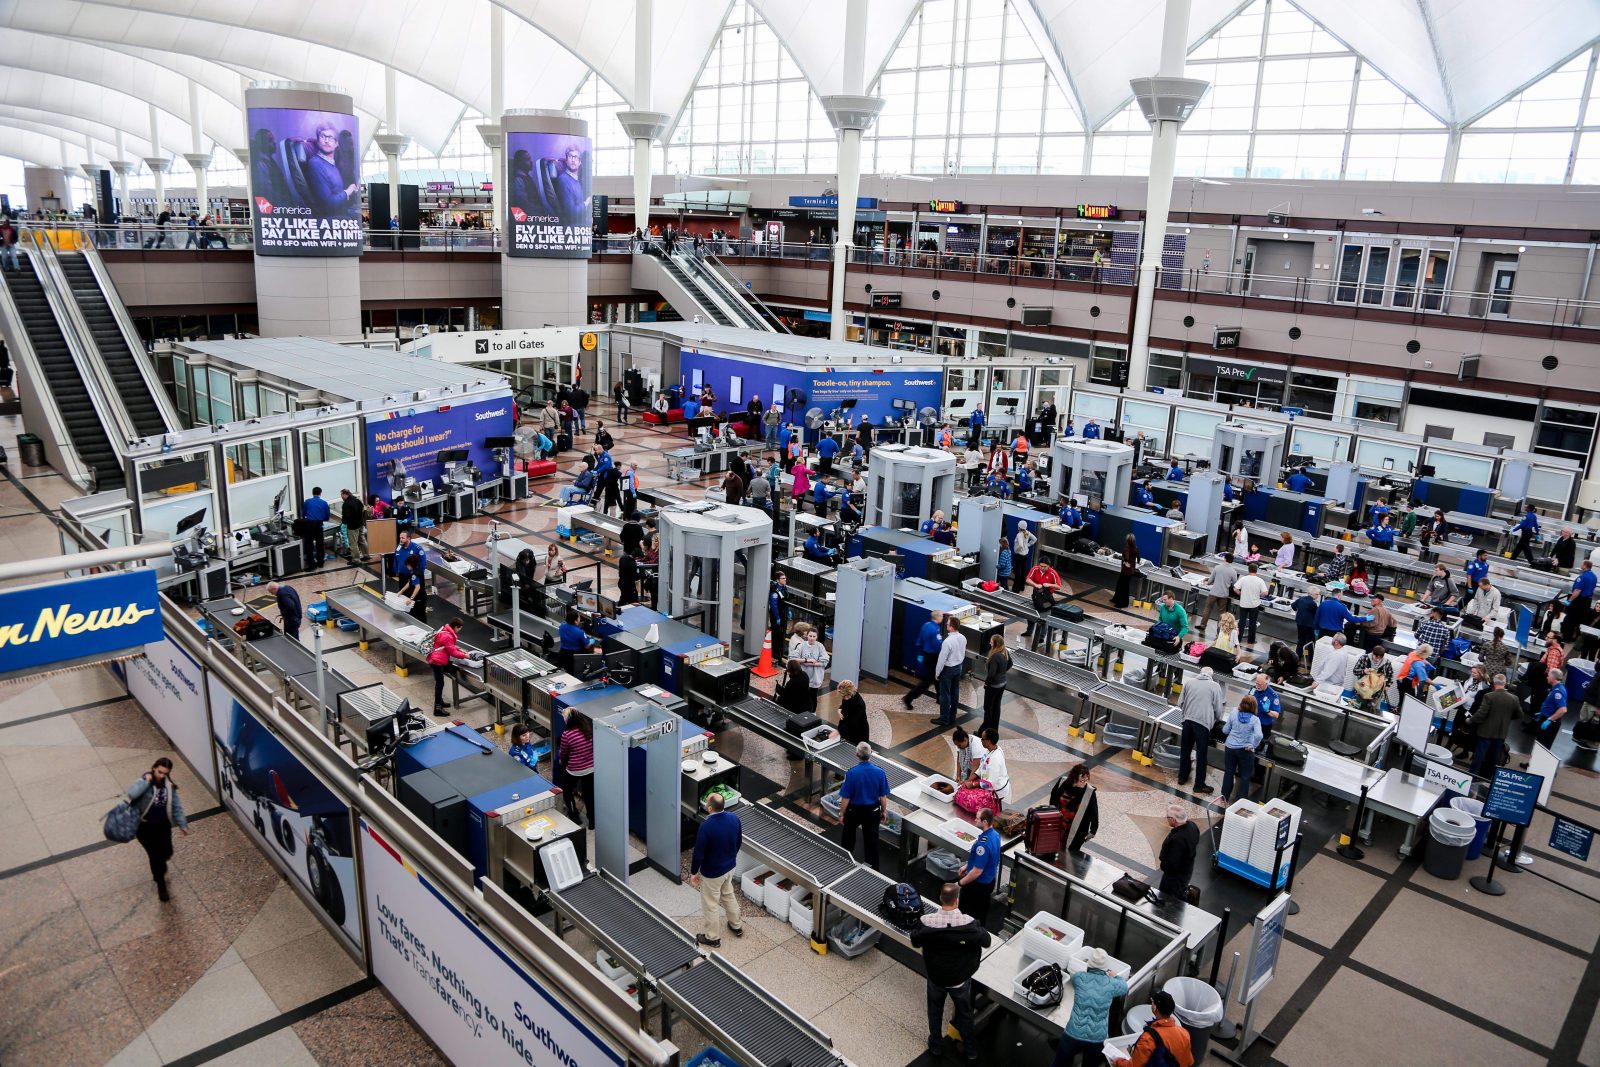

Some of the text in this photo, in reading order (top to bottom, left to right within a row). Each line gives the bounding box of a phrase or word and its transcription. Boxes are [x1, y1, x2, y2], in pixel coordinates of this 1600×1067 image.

[273, 206, 312, 215] america
[261, 218, 282, 228] FLY
[284, 218, 317, 229] LIKE
[320, 219, 331, 229] A
[527, 214, 559, 222] america
[262, 229, 285, 238] PAY
[287, 229, 320, 239] LIKE
[323, 230, 341, 239] AN
[516, 225, 535, 234] FLY
[537, 225, 563, 234] LIKE
[565, 226, 573, 235] A
[516, 234, 536, 243] PAY
[538, 235, 565, 243] LIKE
[567, 235, 580, 244] AN
[493, 340, 544, 350] to all Gates
[1216, 366, 1245, 377] TSA Pre
[475, 408, 505, 420] Southwest
[376, 425, 424, 442] No charge for
[401, 435, 424, 449] should
[29, 603, 155, 642] News
[662, 721, 673, 734] 10
[1427, 768, 1441, 779] TSA
[1443, 775, 1456, 785] Pre
[1498, 771, 1510, 779] TSA
[378, 918, 410, 962] That's
[376, 895, 398, 928] Low
[399, 919, 429, 961] fares.
[432, 951, 482, 1018] Nothing
[484, 1006, 499, 1031] to
